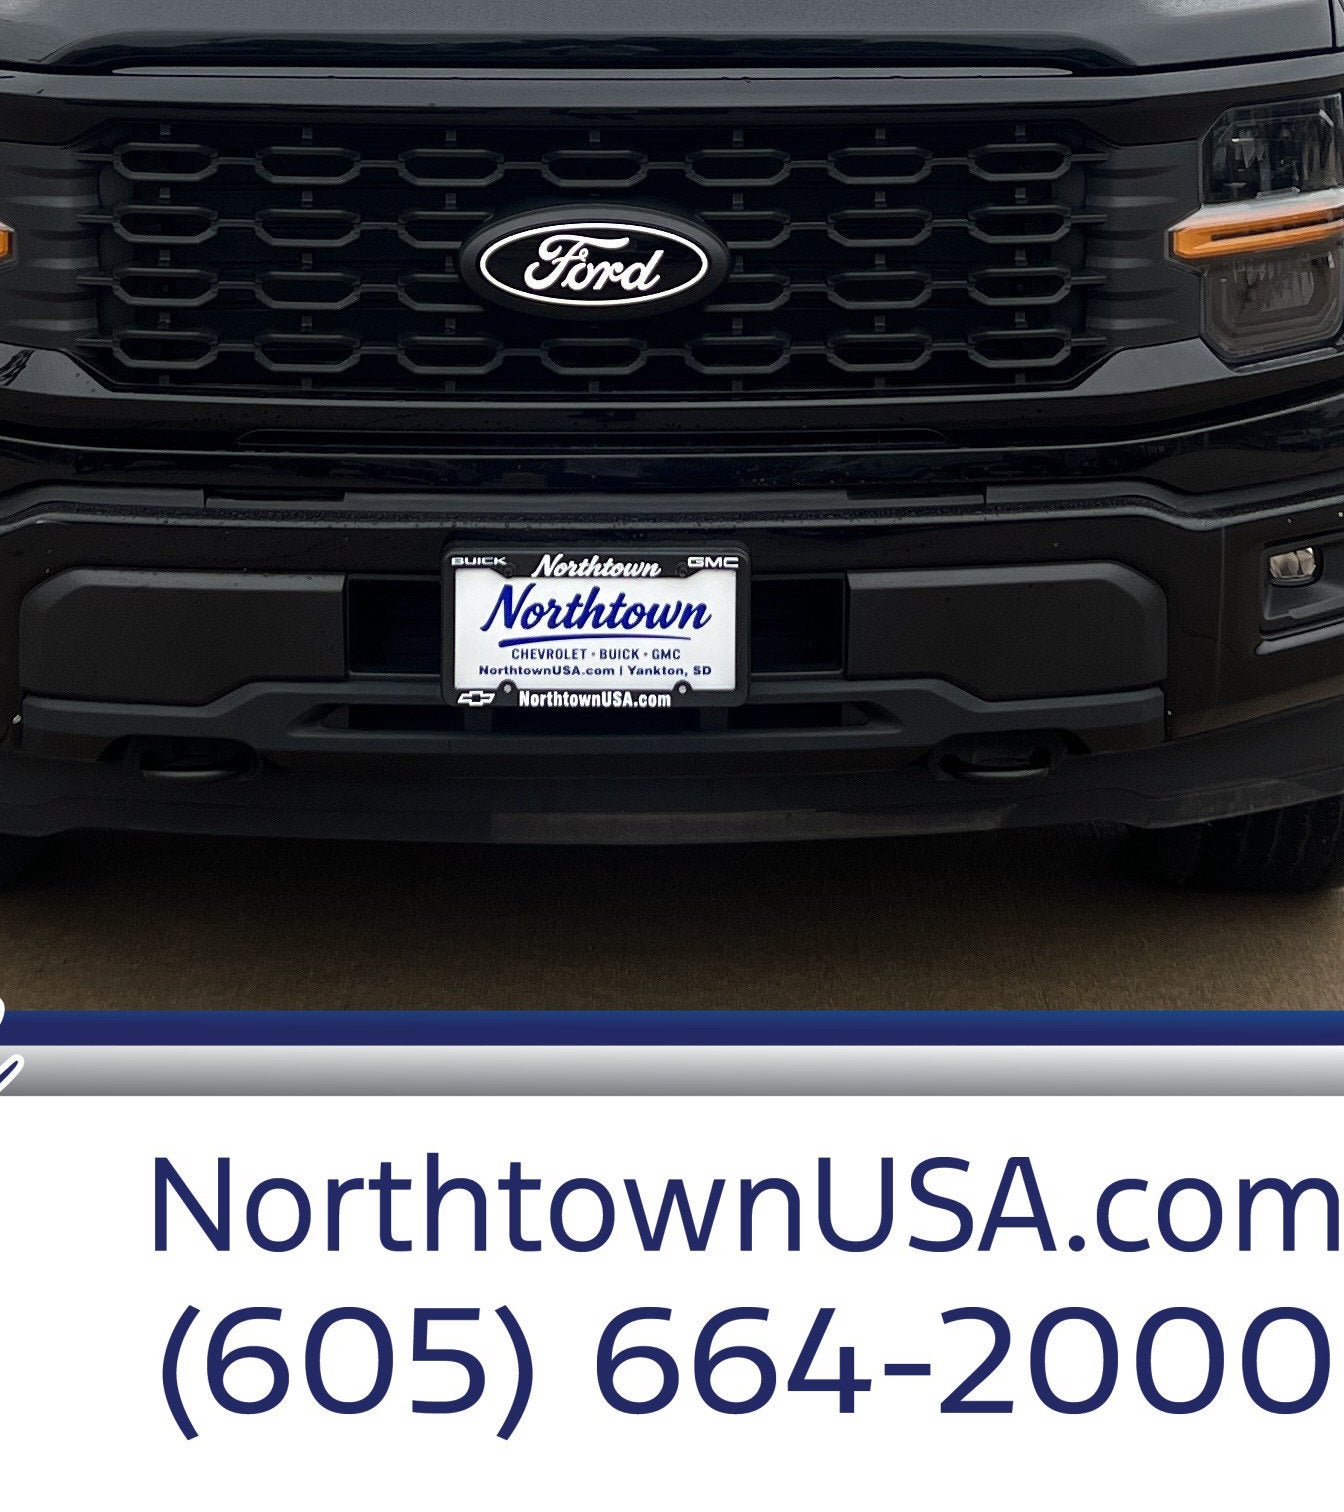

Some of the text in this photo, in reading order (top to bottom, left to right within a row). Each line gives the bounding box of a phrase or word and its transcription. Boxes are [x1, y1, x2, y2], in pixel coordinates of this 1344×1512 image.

[524, 234, 665, 291] Ford
[451, 556, 507, 566] BUICK
[531, 553, 662, 578] Northtown
[687, 556, 739, 569] GMC
[480, 582, 712, 632] Northtown
[511, 648, 681, 660] CHEVROLET BUICK GMC
[479, 665, 712, 678] NorthtownUSA.com Yankton, SD
[519, 690, 672, 707] NorthtownUSA.com
